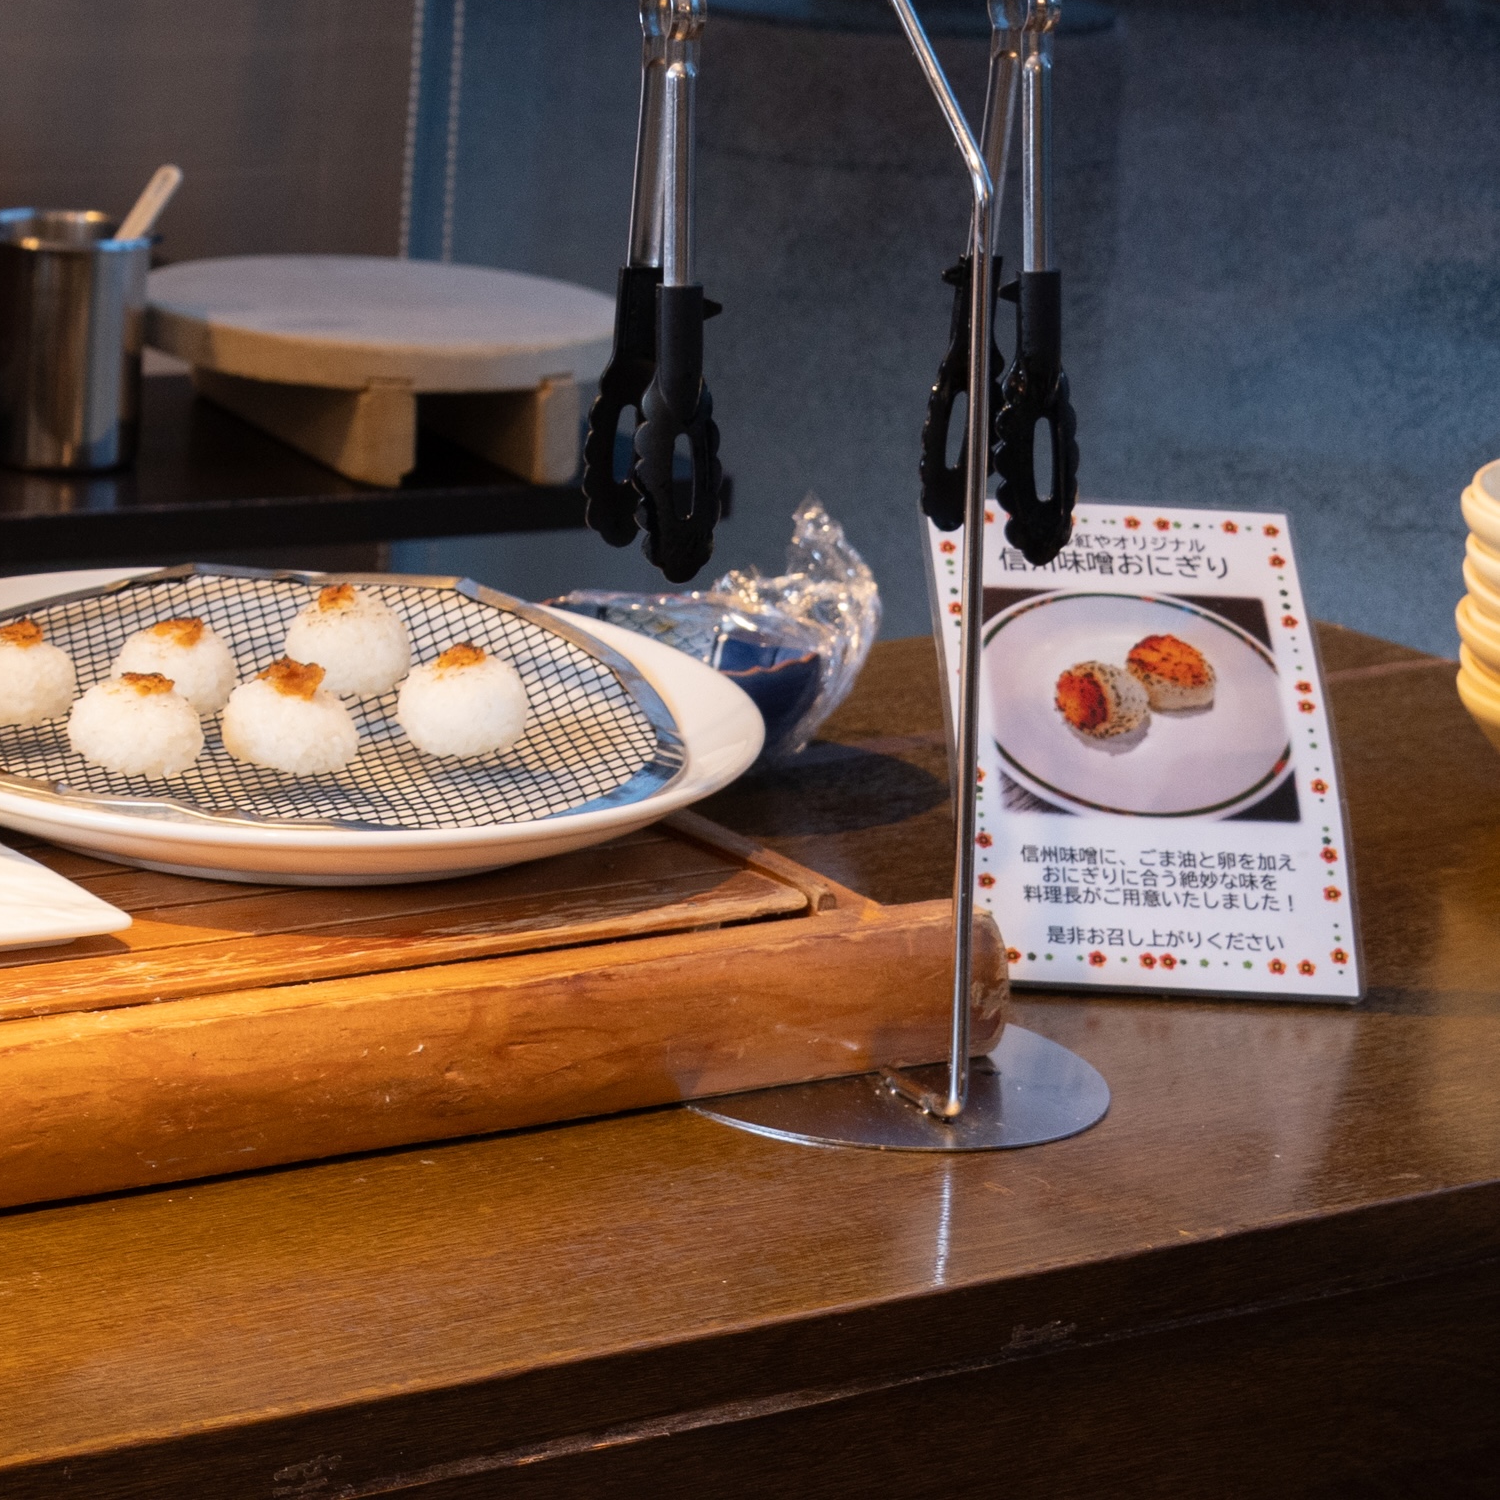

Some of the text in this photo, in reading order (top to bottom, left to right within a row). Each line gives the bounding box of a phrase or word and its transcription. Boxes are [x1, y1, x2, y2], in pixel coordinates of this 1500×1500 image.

[1065, 533, 1206, 553] 紅やオリジナル
[1020, 844, 1297, 872] 信州味噌に、ごま油と卵を加え
[1041, 866, 1278, 891] おにぎりに合う絶妙な味を
[1022, 885, 1295, 912] 料理長がご用意いたしました!
[1047, 925, 1285, 952] 是非お召し上がりください
